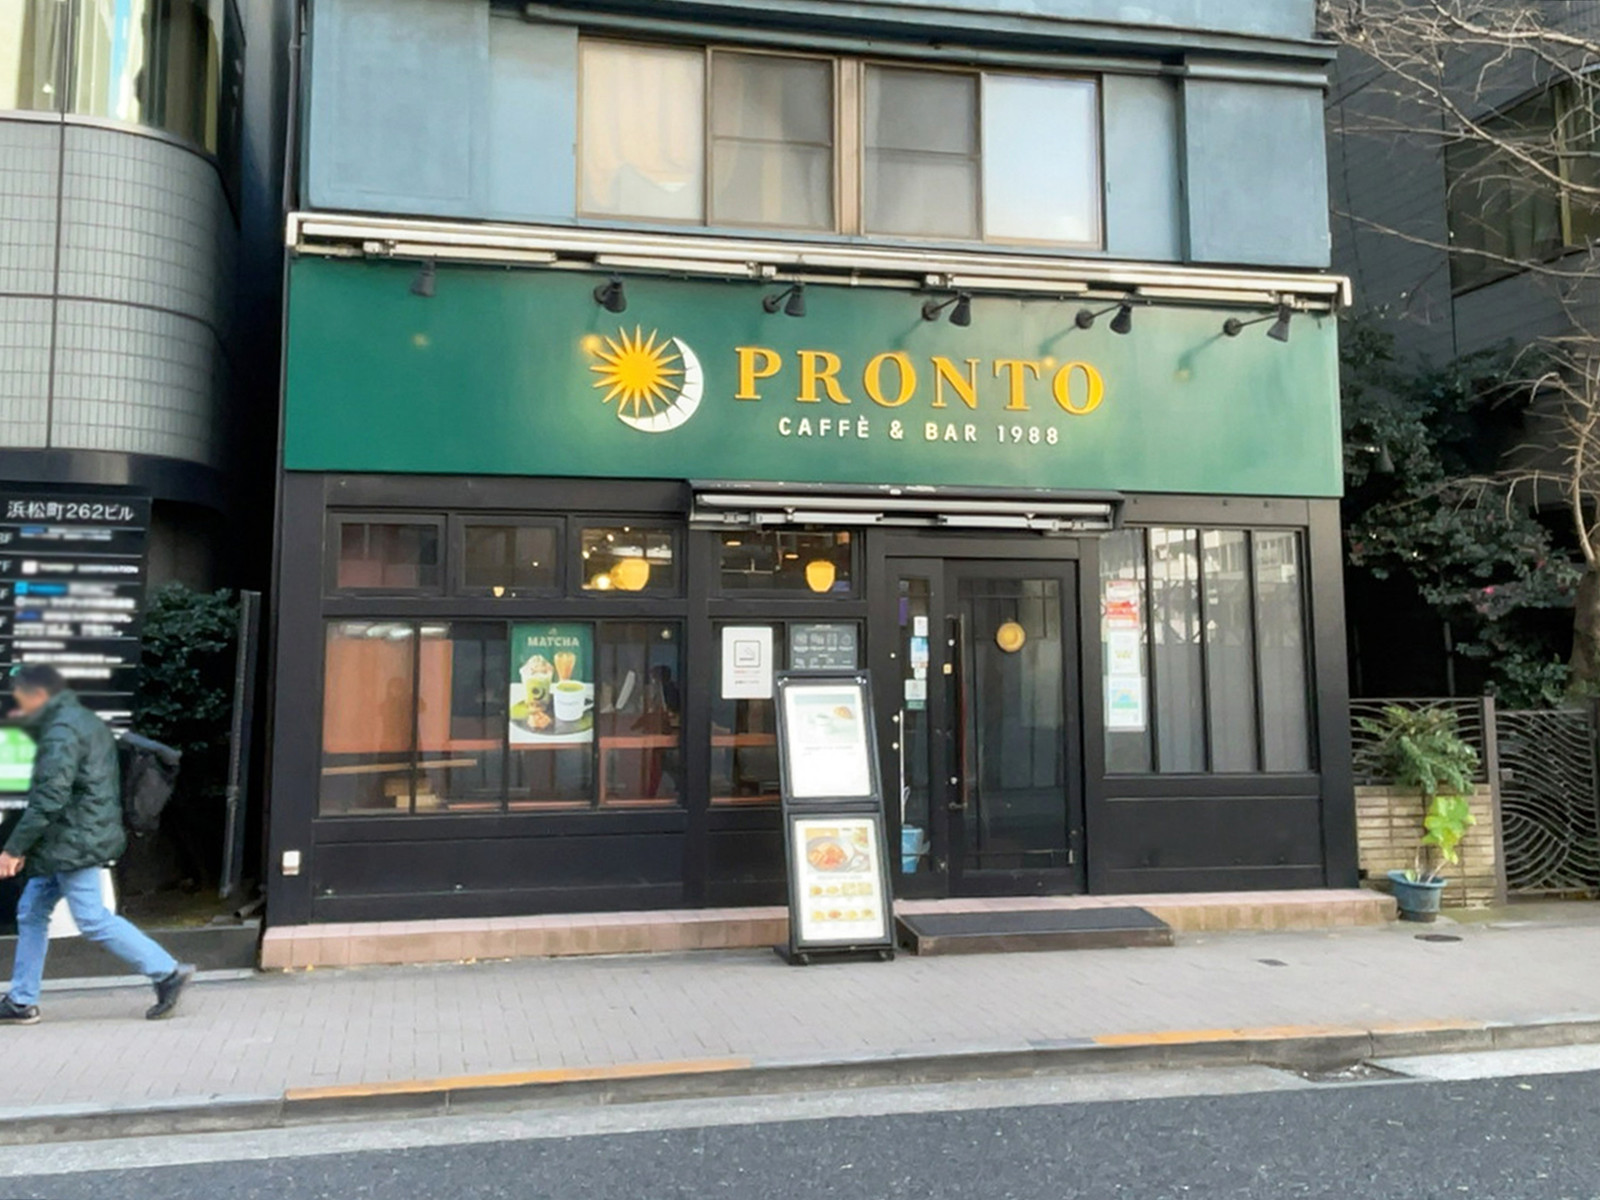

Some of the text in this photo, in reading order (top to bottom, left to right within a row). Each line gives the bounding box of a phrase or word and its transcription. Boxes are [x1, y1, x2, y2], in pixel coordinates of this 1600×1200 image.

[735, 346, 1105, 415] PRONTO
[779, 415, 1059, 445] CAFFÈ & BAR 1988
[7, 500, 134, 521] 浜松町262ビル
[527, 637, 579, 647] MATCHA
